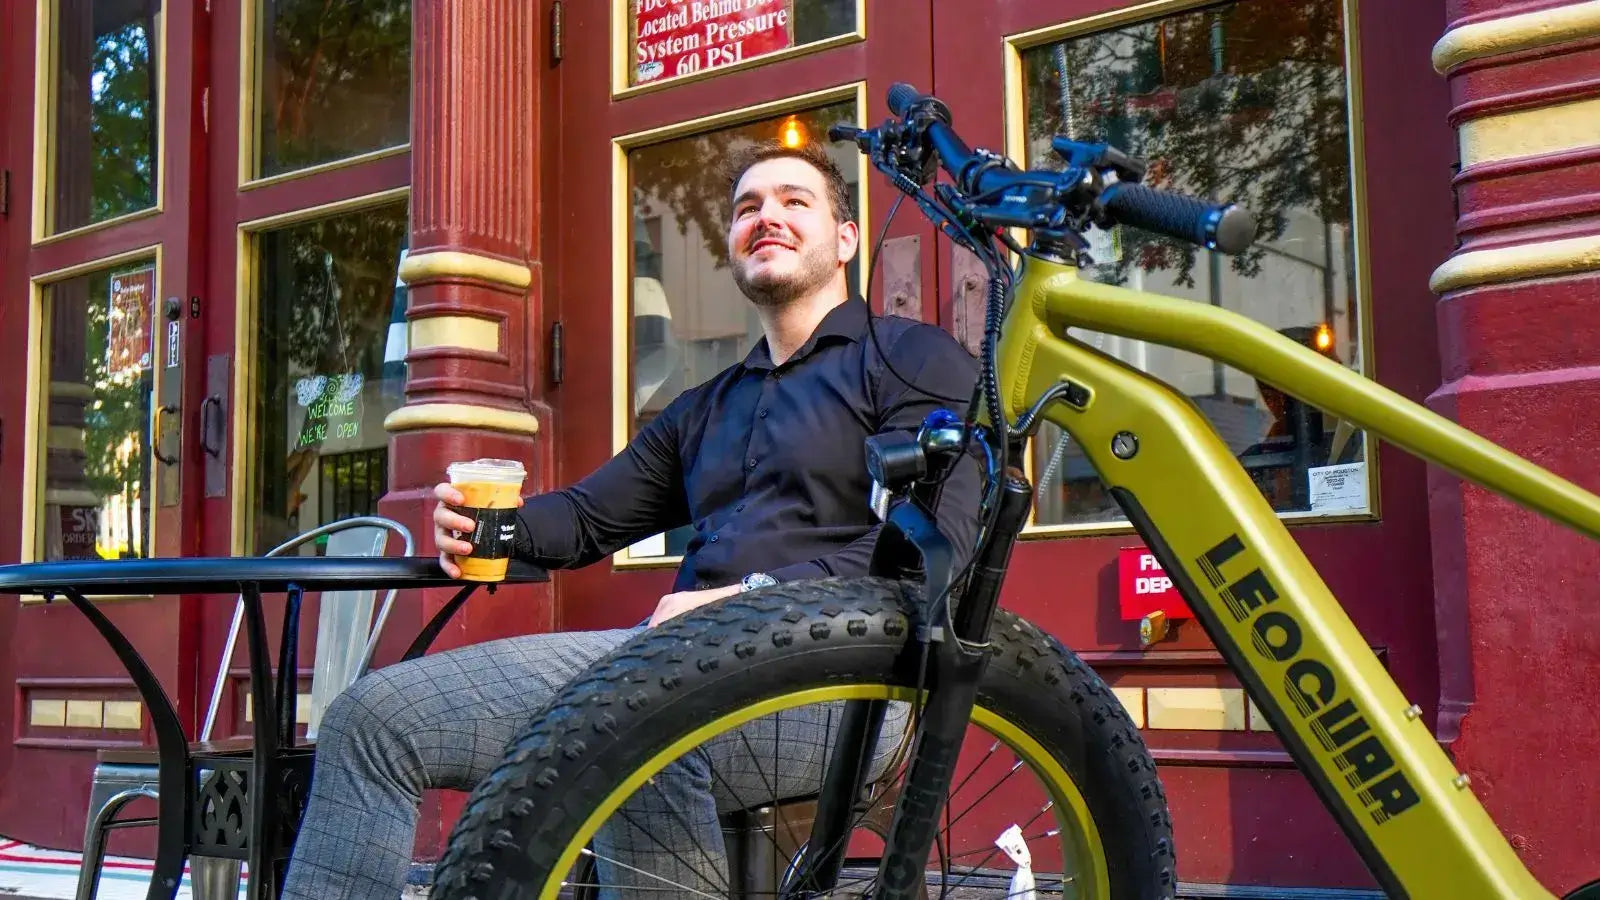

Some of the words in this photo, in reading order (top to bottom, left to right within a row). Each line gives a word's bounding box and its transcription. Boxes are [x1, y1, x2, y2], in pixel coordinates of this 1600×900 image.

[636, 7, 687, 38] Located
[637, 33, 699, 63] System
[706, 9, 787, 46] Pressure
[676, 53, 700, 75] 60
[706, 41, 744, 69] PSI
[308, 402, 353, 419] WELCOME
[299, 424, 327, 446] WE'RE
[336, 421, 359, 439] OPEN
[1135, 576, 1174, 595] DEP
[1196, 533, 1421, 826] LEOGUAR
